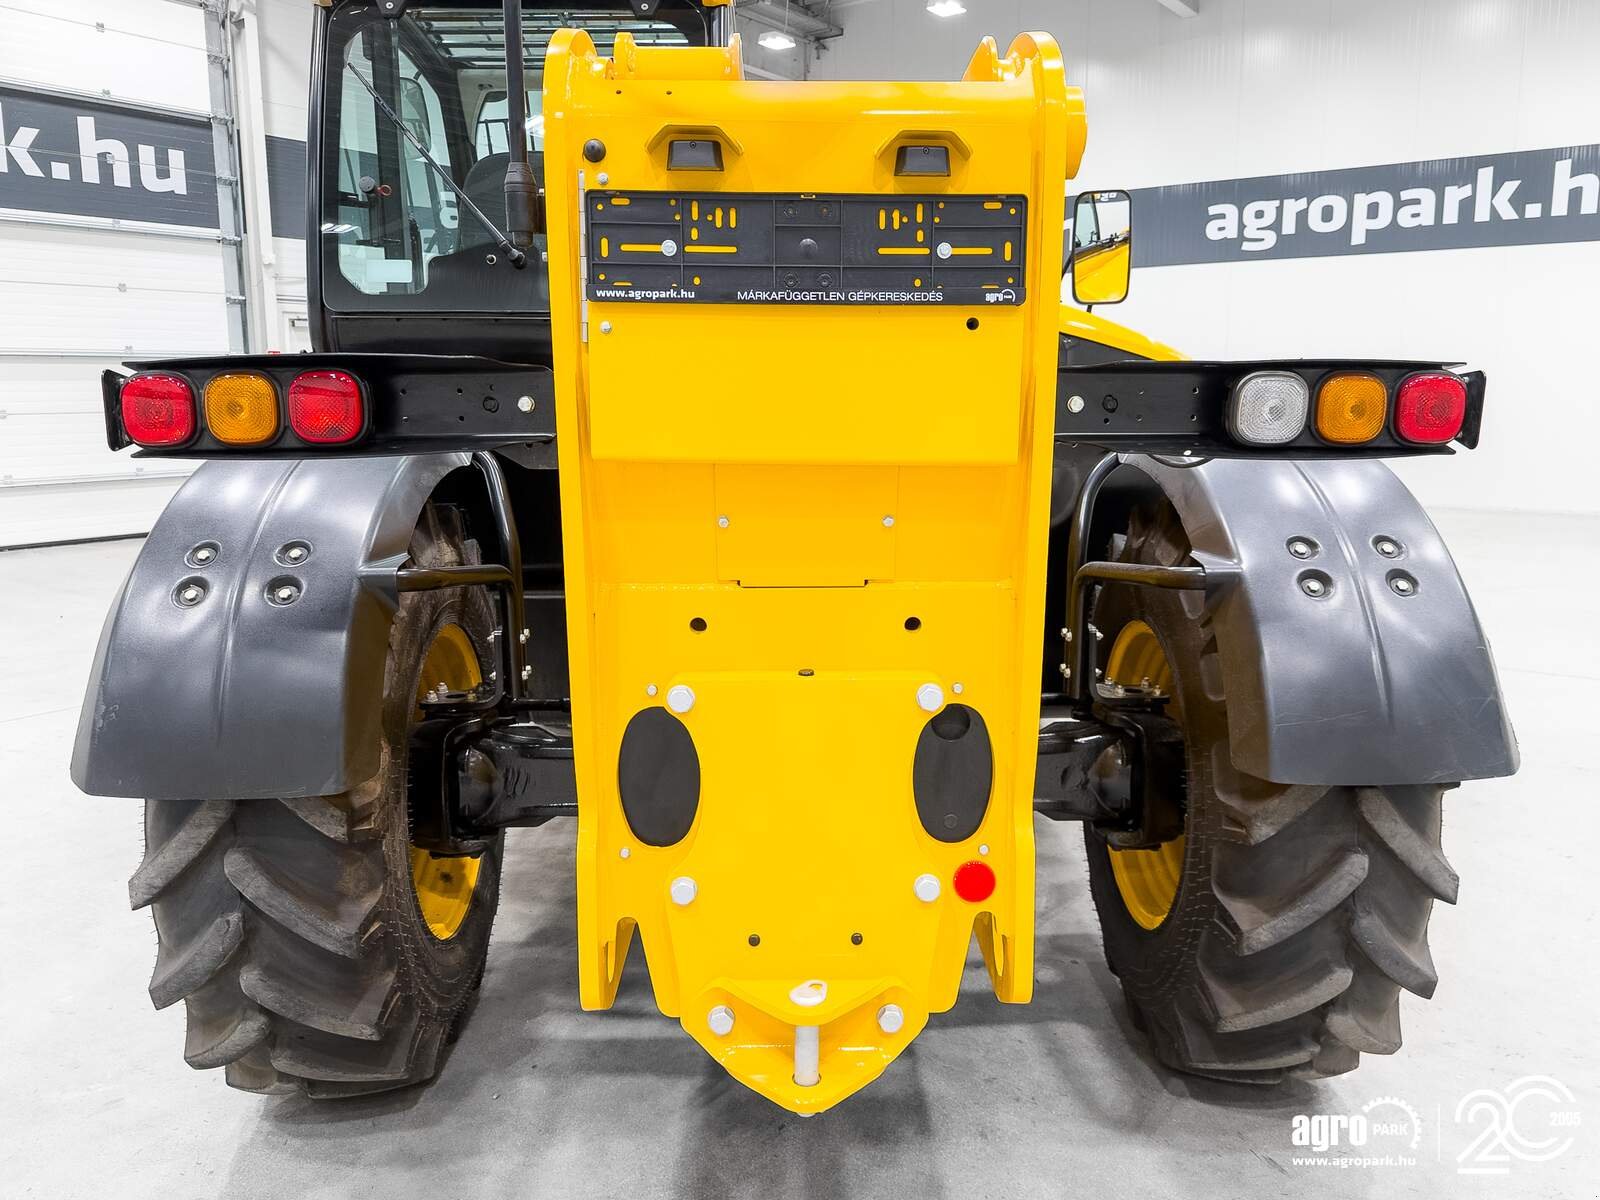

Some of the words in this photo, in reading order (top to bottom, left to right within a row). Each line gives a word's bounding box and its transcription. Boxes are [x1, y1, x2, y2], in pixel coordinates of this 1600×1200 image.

[1205, 159, 1600, 251] agropark.h
[596, 288, 695, 300] www.agropark.hu
[737, 290, 845, 302] MÁRKAFÜGGETLEN
[848, 290, 944, 303] GÉPKERESKEDÉS
